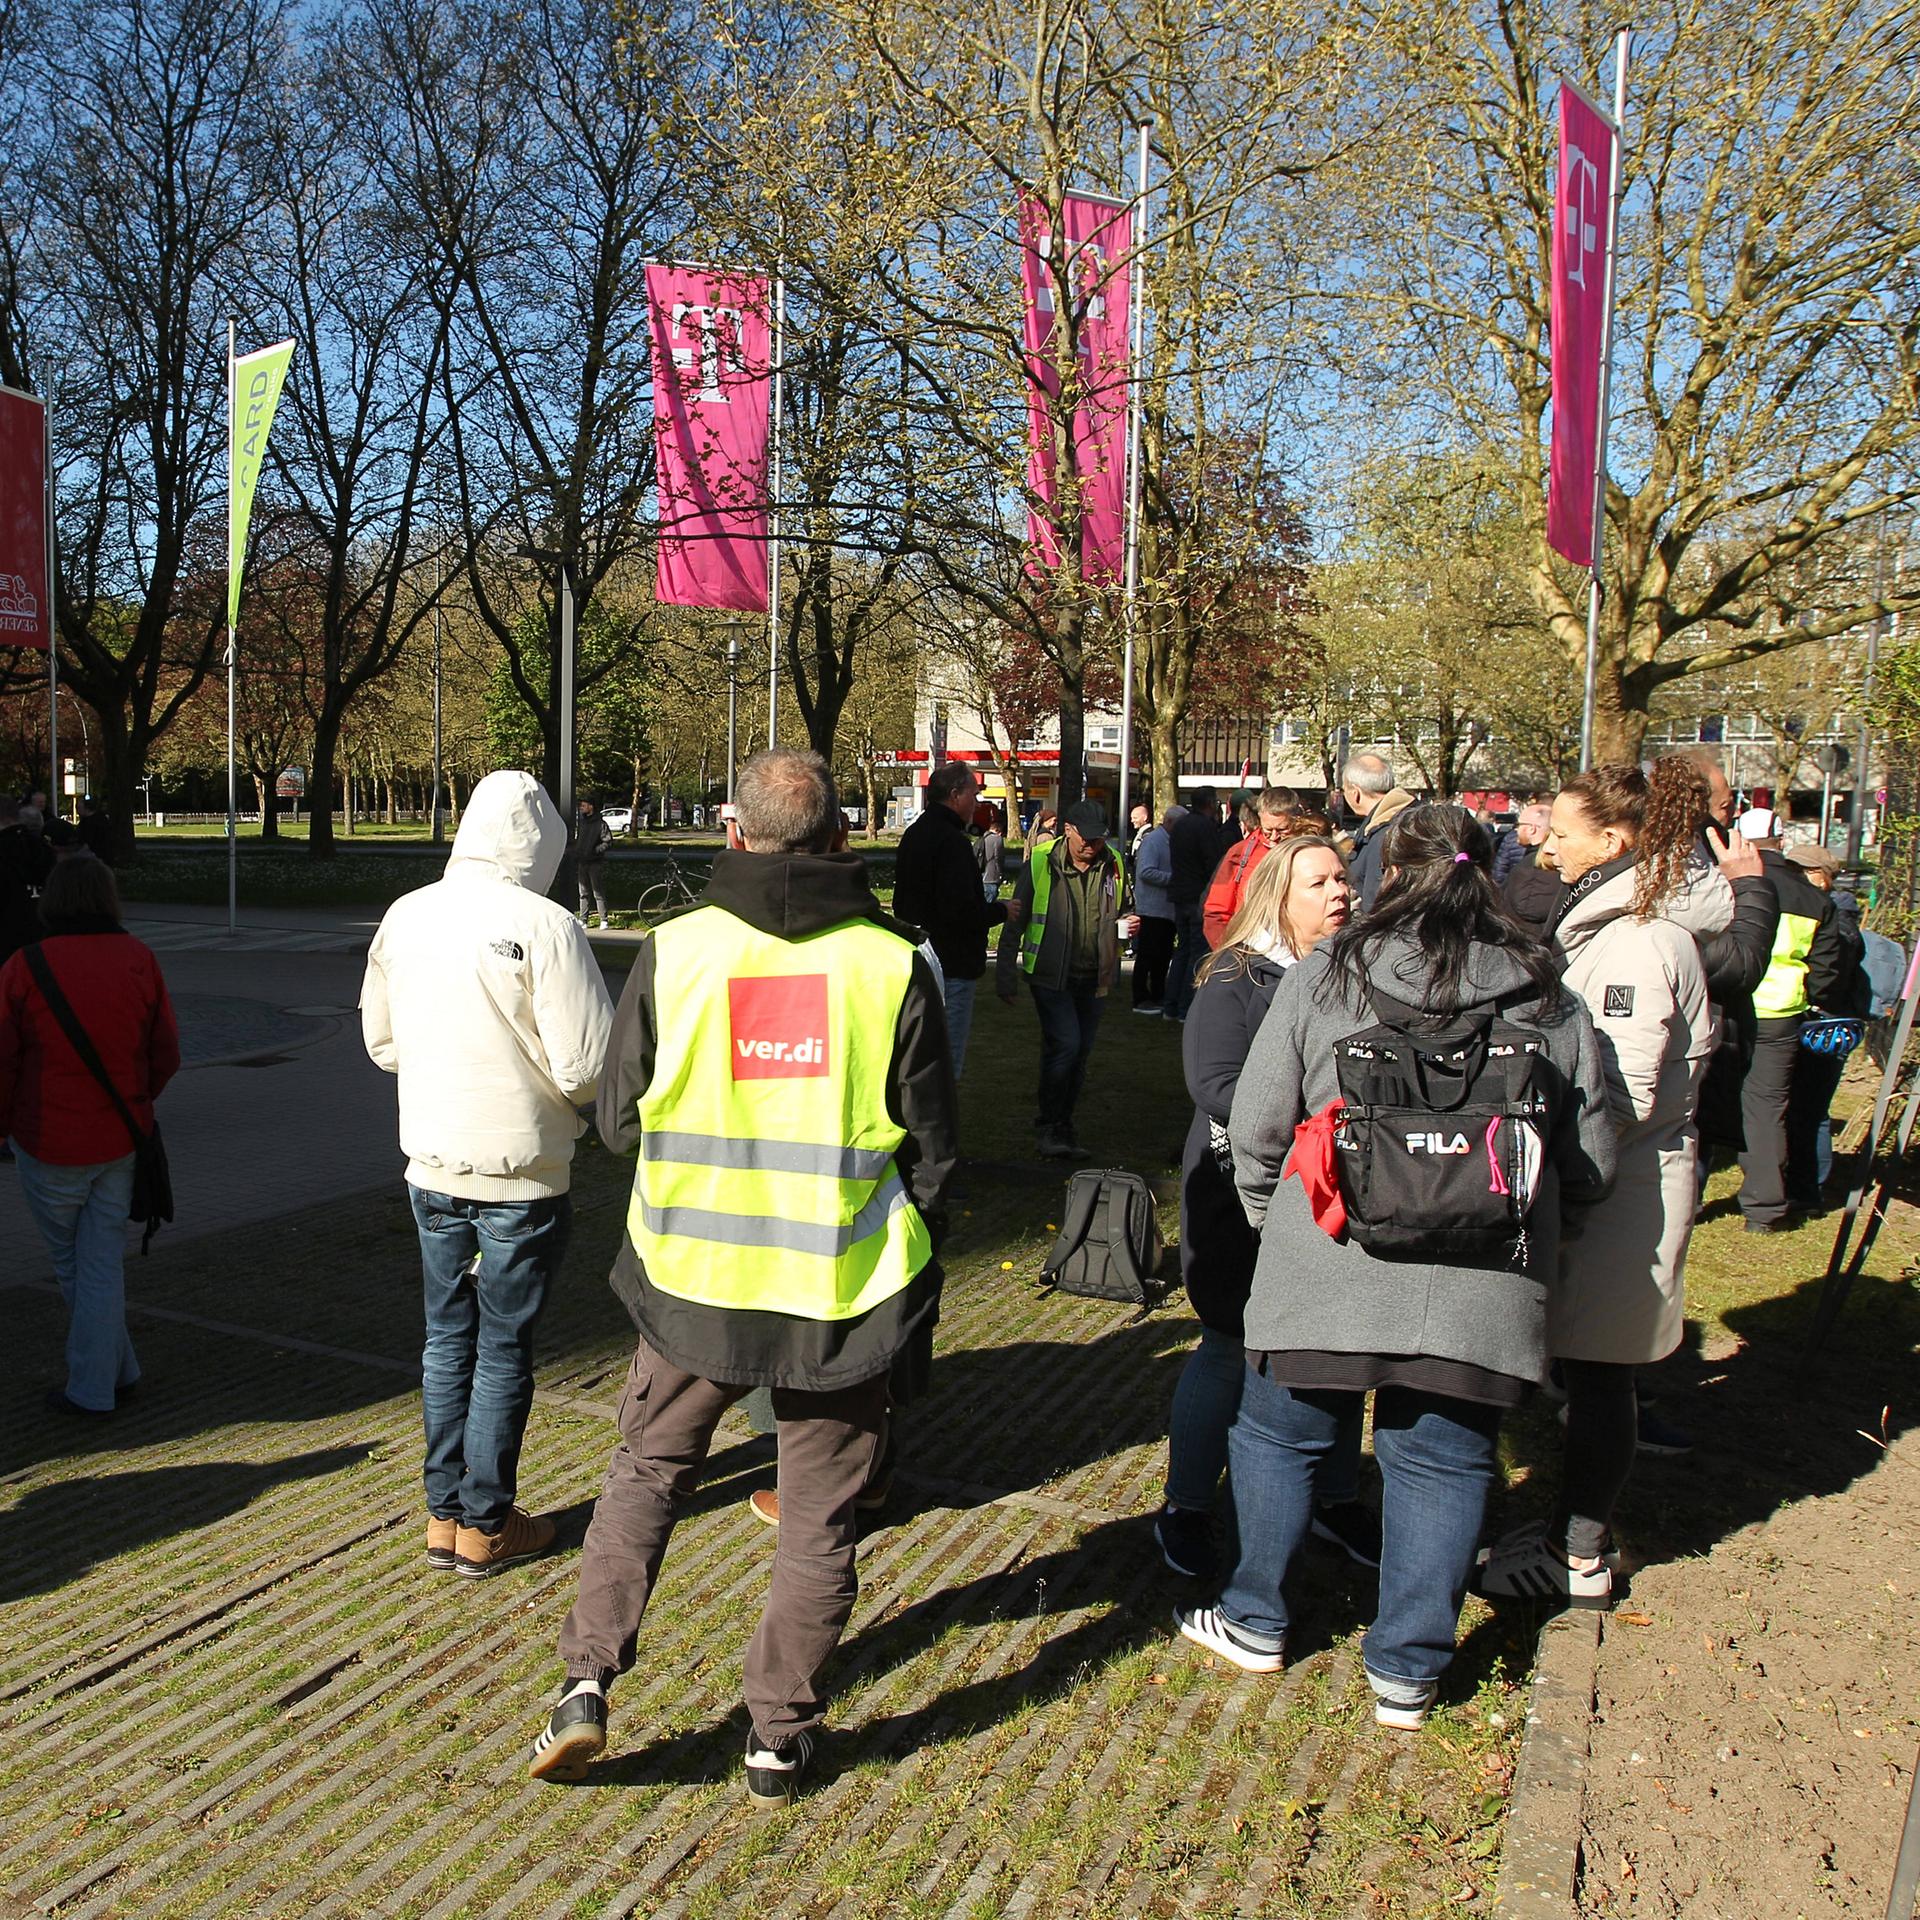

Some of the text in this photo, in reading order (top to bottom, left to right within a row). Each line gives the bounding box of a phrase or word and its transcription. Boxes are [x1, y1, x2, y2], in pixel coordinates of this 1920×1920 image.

[672, 303, 743, 404] T
[736, 1037, 823, 1064] ver.di
[1348, 1047, 1374, 1059] FILA
[1488, 1045, 1515, 1057] FILA
[1337, 1139, 1358, 1151] FILA
[1406, 1132, 1471, 1155] FILA
